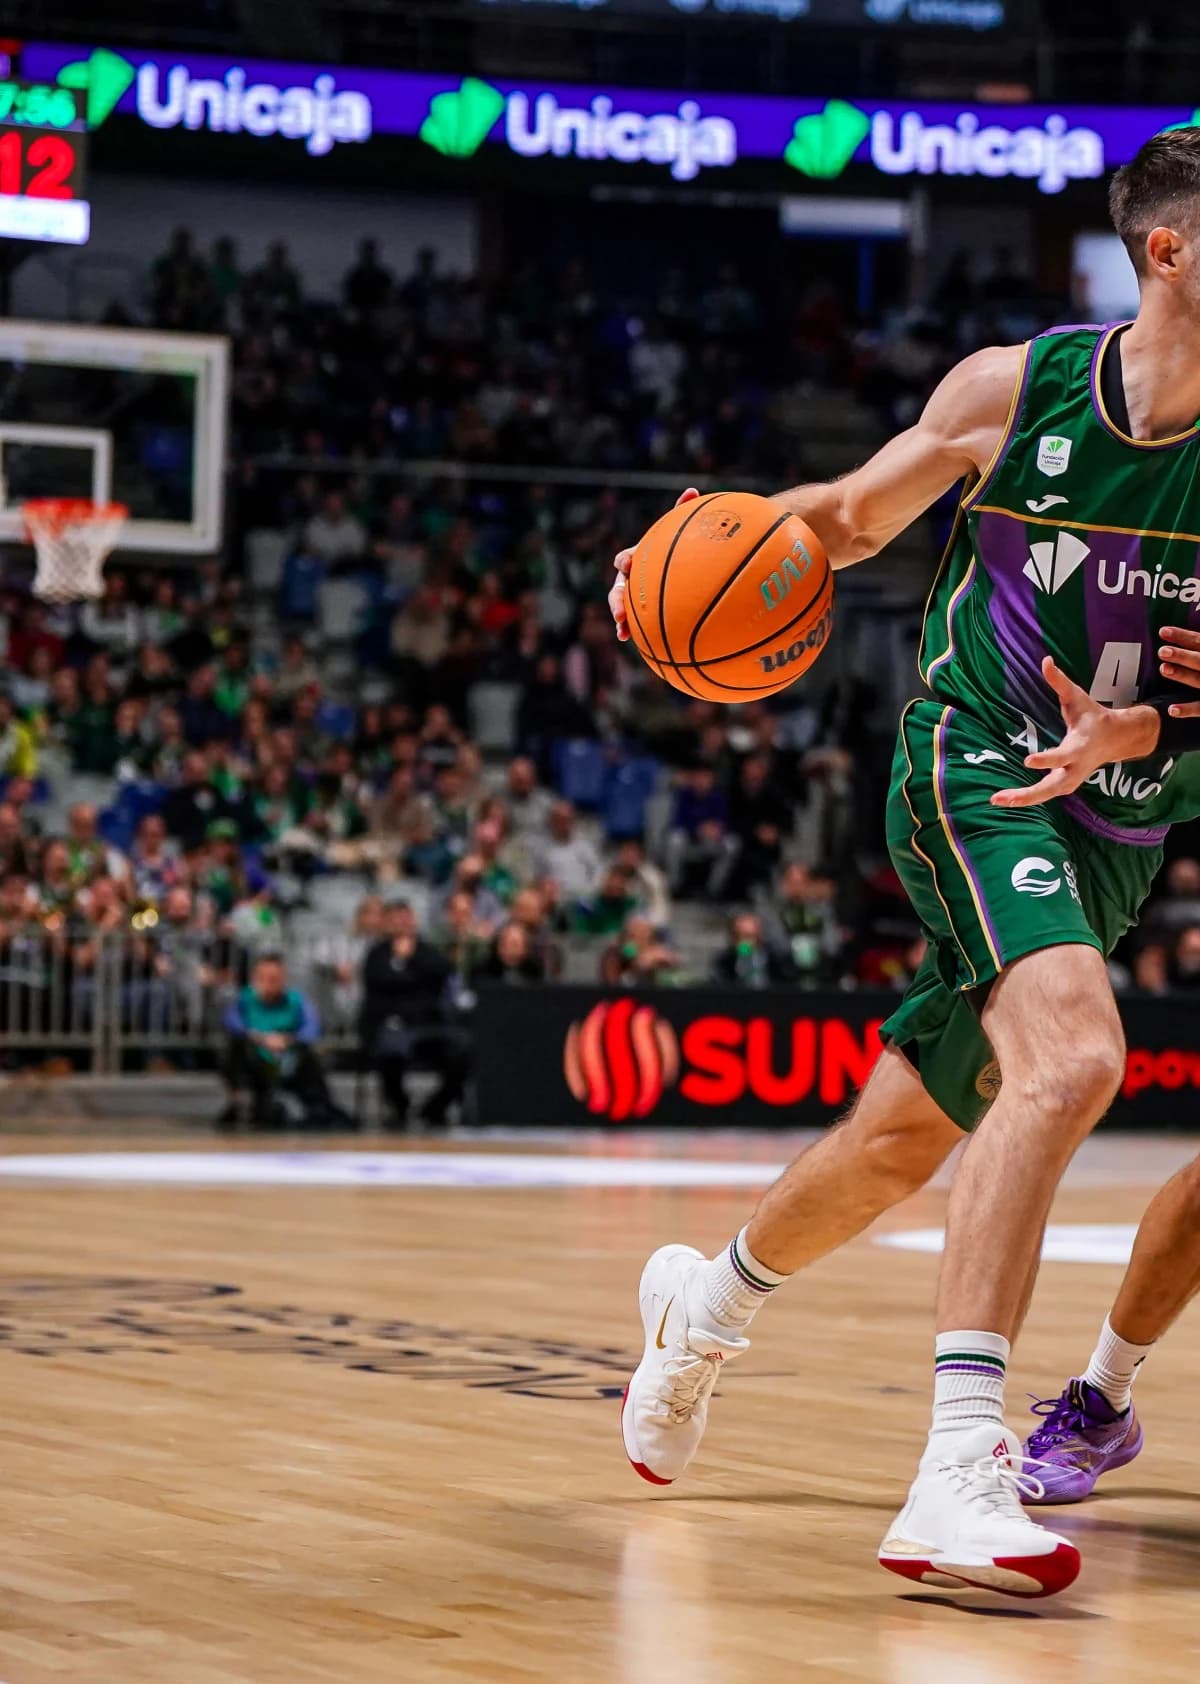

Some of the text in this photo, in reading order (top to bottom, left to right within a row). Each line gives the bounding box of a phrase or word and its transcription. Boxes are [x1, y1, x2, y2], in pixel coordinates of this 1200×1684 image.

[137, 63, 371, 155] Unicaja
[506, 92, 737, 180] Unicaja
[870, 111, 1105, 194] Unicaja
[1088, 641, 1142, 710] 4
